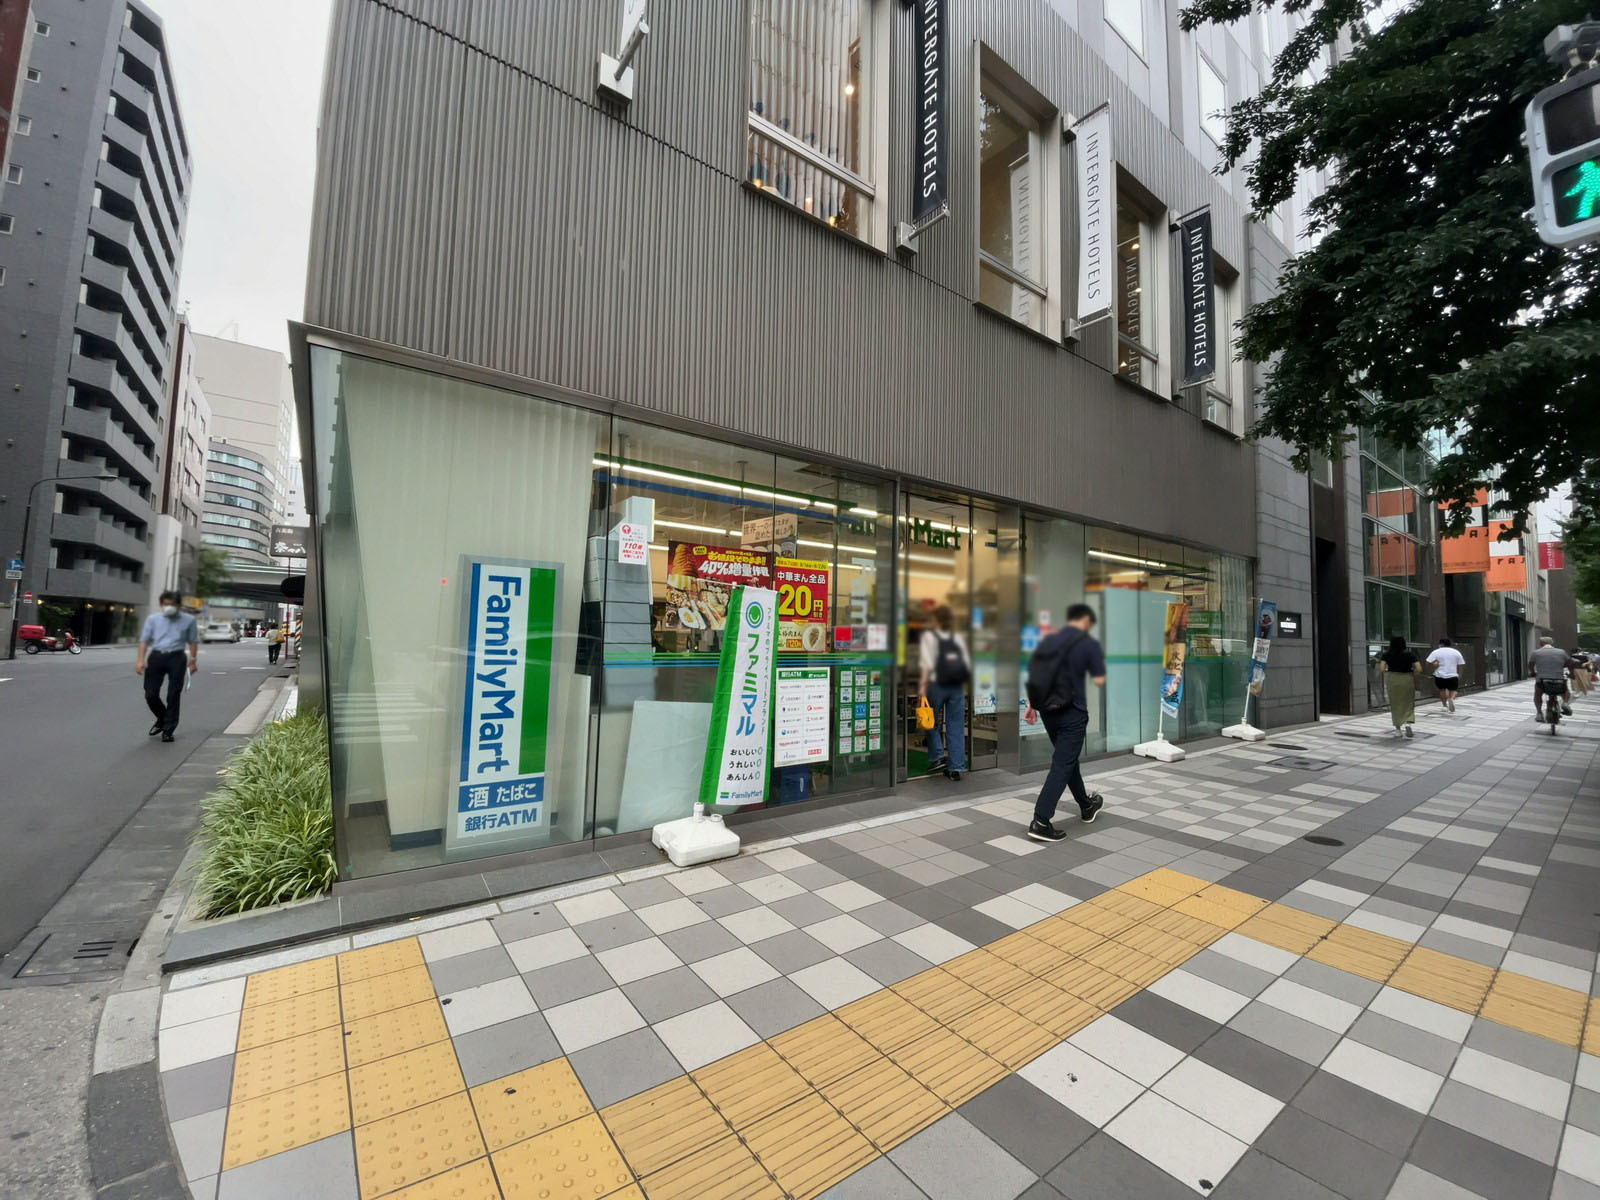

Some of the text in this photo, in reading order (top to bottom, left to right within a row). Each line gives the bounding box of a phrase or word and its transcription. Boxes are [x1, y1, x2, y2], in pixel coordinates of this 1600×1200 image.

[923, 111, 937, 198] HOTELS
[1086, 131, 1101, 300] INTERGATE HOTELS
[1190, 226, 1206, 367] INTERGATE HOTELS
[777, 571, 826, 584] 中華まん全品
[476, 575, 522, 774] FamilyMart
[736, 633, 760, 736] ファミマル
[726, 772, 754, 781] あんしん
[729, 760, 756, 769] うれしい
[468, 782, 537, 808] 酒 たばこ
[731, 790, 763, 799] FamilyMart
[465, 807, 538, 832] 銀行ATM
